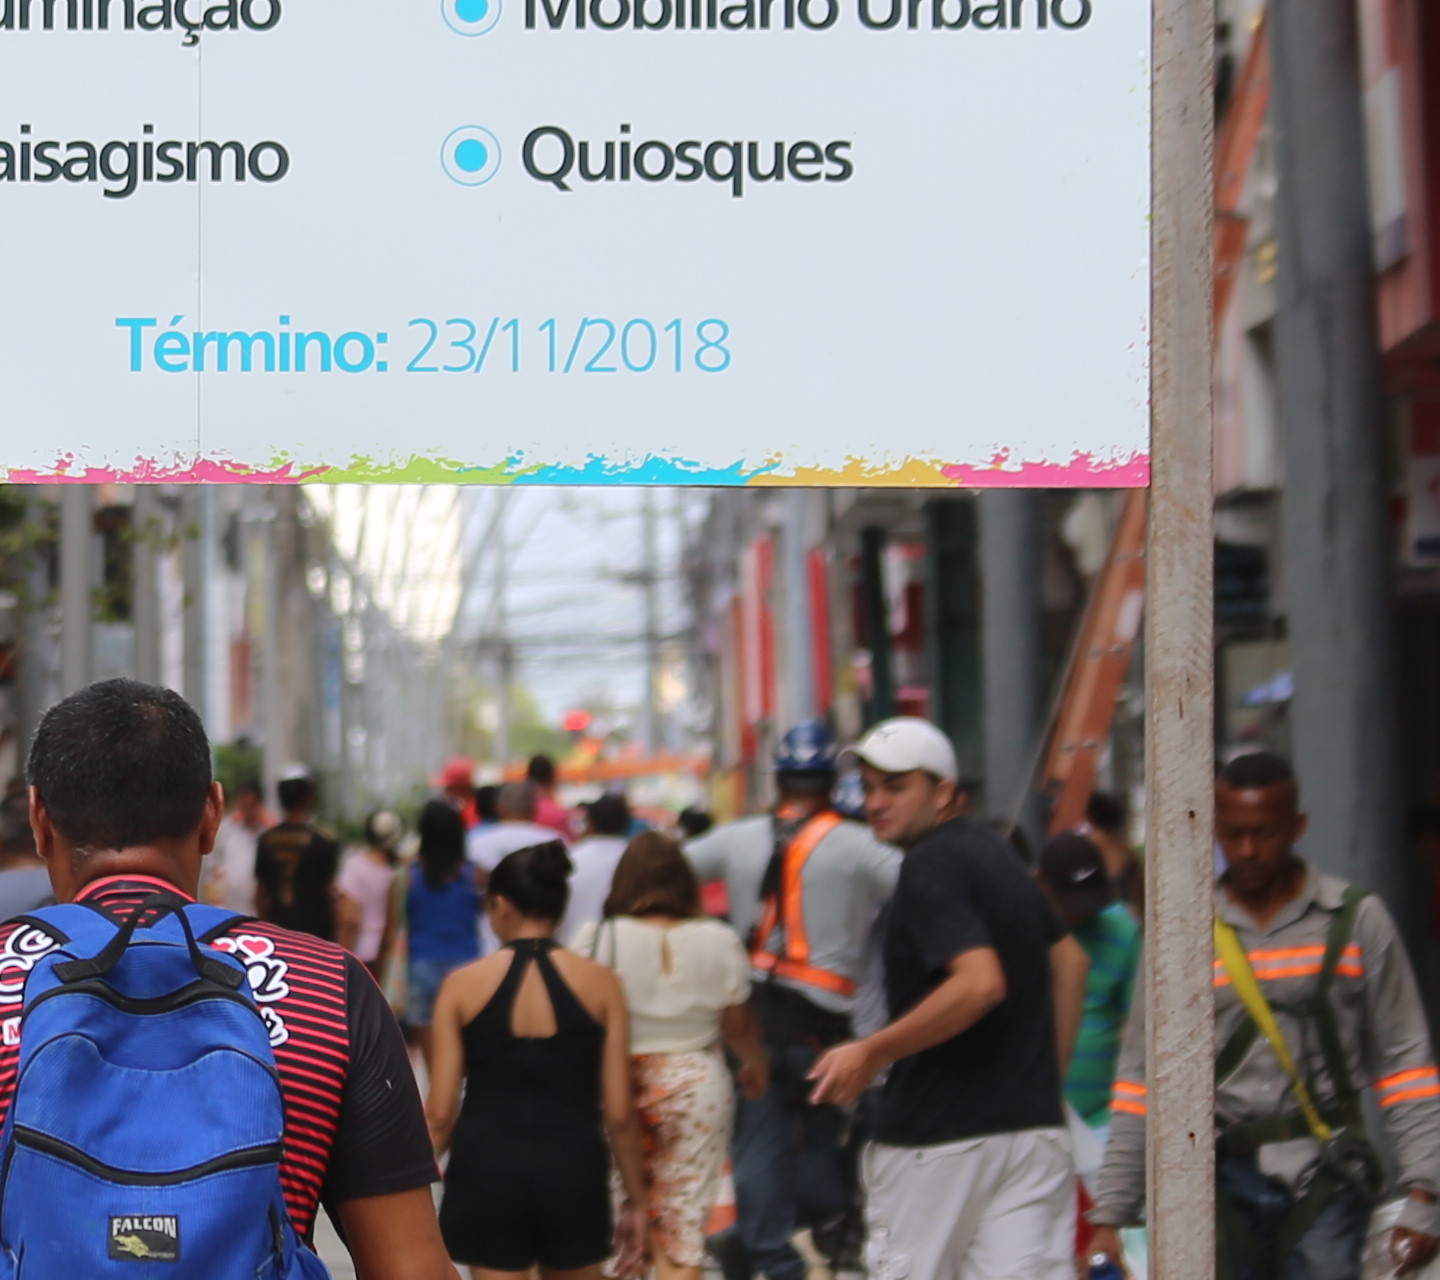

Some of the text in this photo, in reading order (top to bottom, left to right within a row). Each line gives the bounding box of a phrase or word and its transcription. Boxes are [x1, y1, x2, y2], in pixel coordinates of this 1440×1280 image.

[522, 124, 854, 198] Quiosques
[115, 315, 388, 373] Término:
[406, 317, 731, 373] 23/11/2018
[112, 1216, 177, 1239] FALCON
